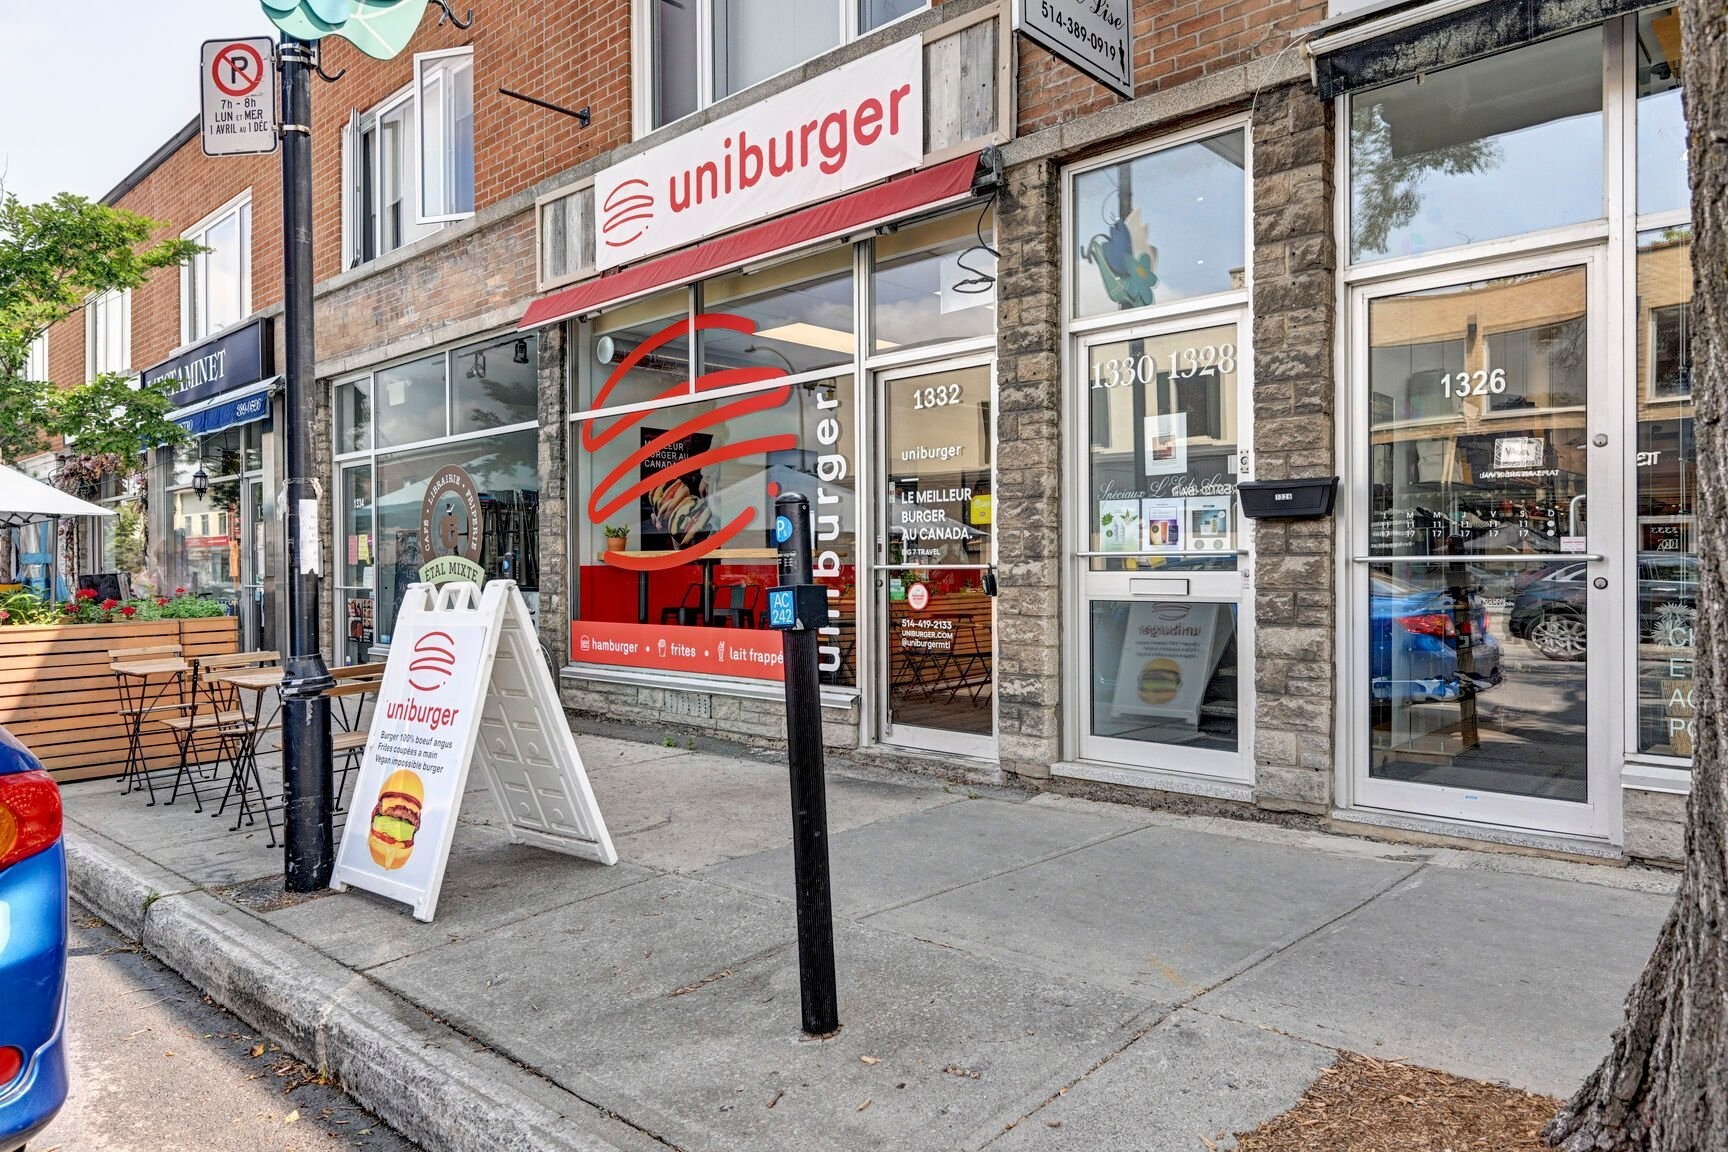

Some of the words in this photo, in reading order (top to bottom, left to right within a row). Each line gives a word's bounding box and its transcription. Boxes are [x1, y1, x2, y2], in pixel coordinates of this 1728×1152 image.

[1090, 0, 1124, 30] Lise
[1041, 1, 1116, 60] 514-389-0919
[220, 100, 232, 110] 7h
[244, 98, 256, 108] 8h
[215, 112, 232, 122] LUN
[244, 110, 263, 120] MER
[210, 125, 213, 135] 1
[216, 122, 238, 134] AVRIL
[669, 84, 911, 213] uniburger
[1091, 354, 1154, 389] 1330
[1168, 343, 1234, 380] 1328
[1440, 368, 1506, 398] 1326
[914, 383, 960, 410] 1332
[902, 446, 962, 460] uniburger
[428, 474, 461, 506] LIBRAIRIE
[902, 491, 914, 504] LE
[916, 488, 972, 504] MEILLEUR
[902, 510, 946, 523] BURGER
[902, 528, 916, 540] AU
[920, 527, 973, 540] CANADA.
[424, 563, 446, 582] ÉTAL
[449, 562, 478, 582] MIXTE
[774, 593, 789, 608] AC
[773, 609, 792, 623] 242
[902, 619, 952, 630] 514-419-2133
[902, 630, 953, 639] UNIBURGER.COM
[592, 638, 638, 655] hamburger
[670, 643, 696, 657] frites
[902, 638, 951, 650] @uniburgermtl
[730, 647, 747, 661] lait
[749, 649, 784, 666] frappé
[387, 698, 459, 730] uniburger
[380, 730, 399, 742] Burger
[400, 733, 414, 744] 100%
[415, 736, 433, 745] boeuf
[433, 739, 453, 750] angus
[377, 742, 393, 752] Frites
[393, 746, 417, 756] coupées
[423, 750, 438, 759] main
[375, 754, 391, 765] Vegan
[391, 757, 422, 770] impossible
[422, 763, 444, 774] burger
